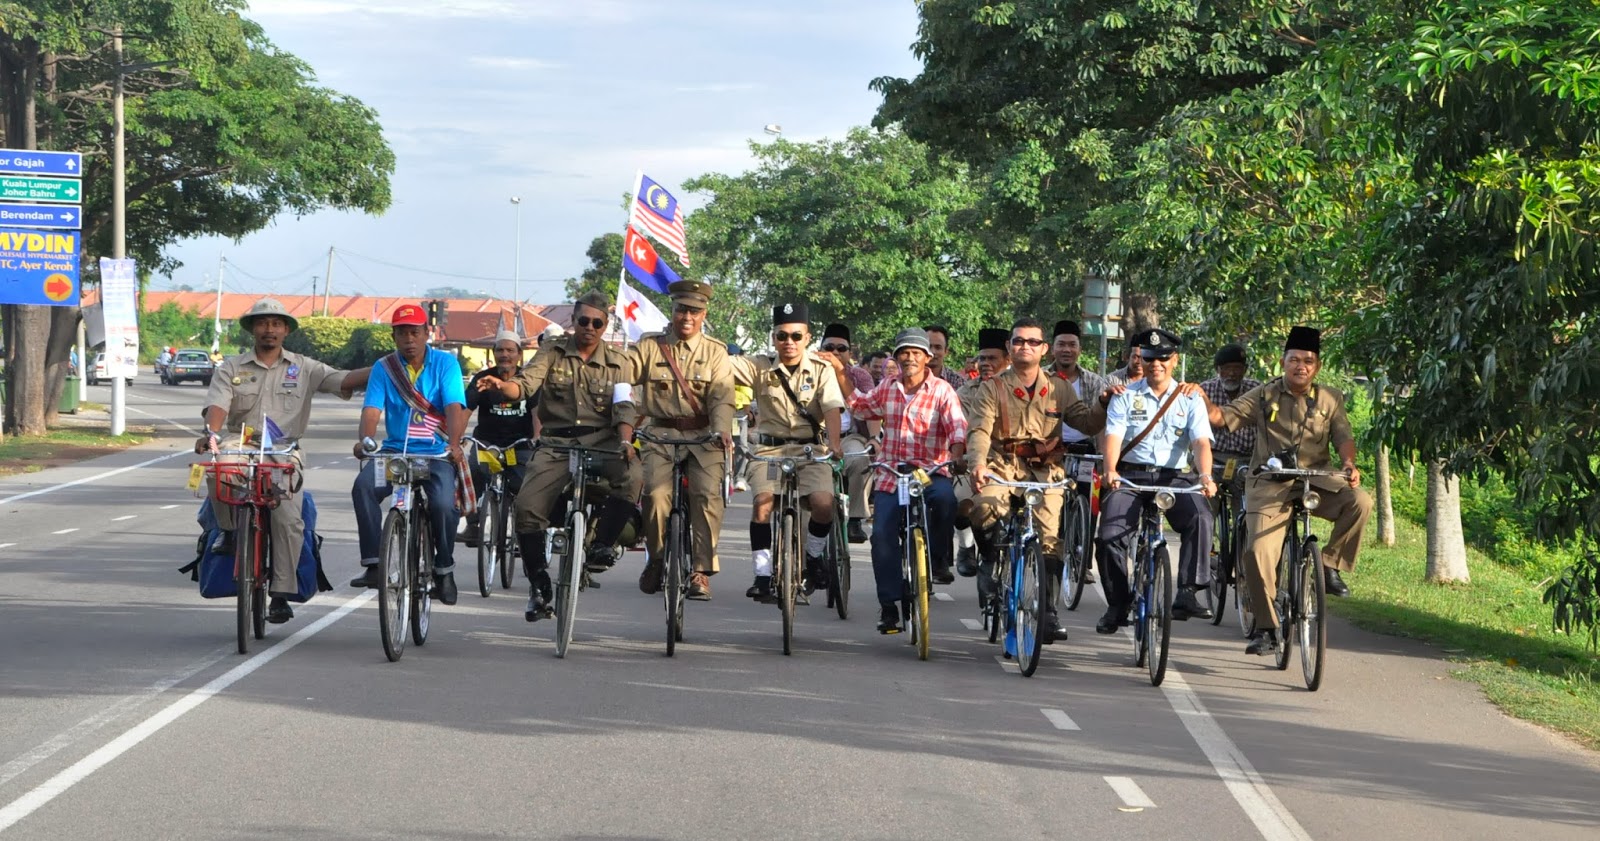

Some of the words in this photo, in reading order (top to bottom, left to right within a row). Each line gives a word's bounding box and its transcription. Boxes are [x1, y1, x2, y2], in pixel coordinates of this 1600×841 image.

[14, 157, 45, 168] Gajah
[2, 179, 27, 188] Kuala
[29, 181, 62, 190] Lumpur
[2, 188, 28, 196] Johor
[30, 189, 56, 198] Bahru
[1, 210, 54, 220] Berendam
[19, 260, 42, 272] Ayer
[44, 261, 73, 271] Keroh
